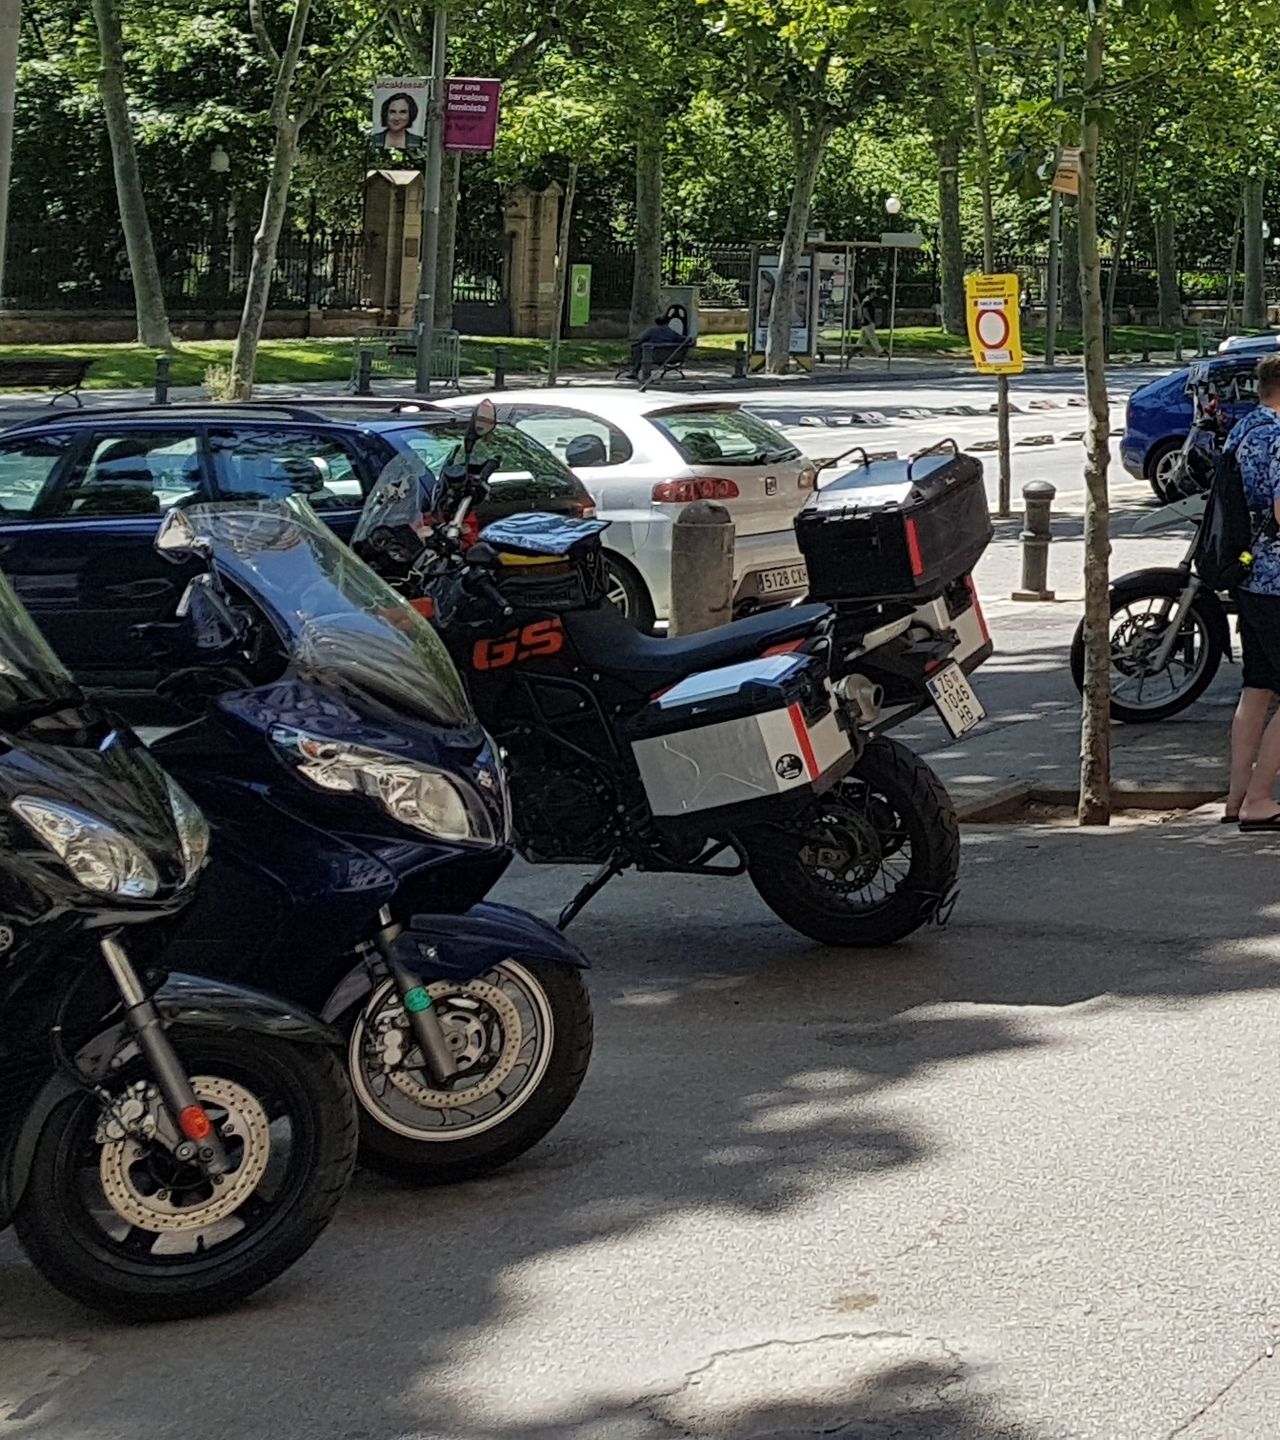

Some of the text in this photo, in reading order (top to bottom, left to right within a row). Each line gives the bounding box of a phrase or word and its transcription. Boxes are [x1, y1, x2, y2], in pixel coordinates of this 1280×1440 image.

[764, 570, 790, 589] 5128
[472, 617, 564, 671] GS
[944, 684, 970, 712] 1046
